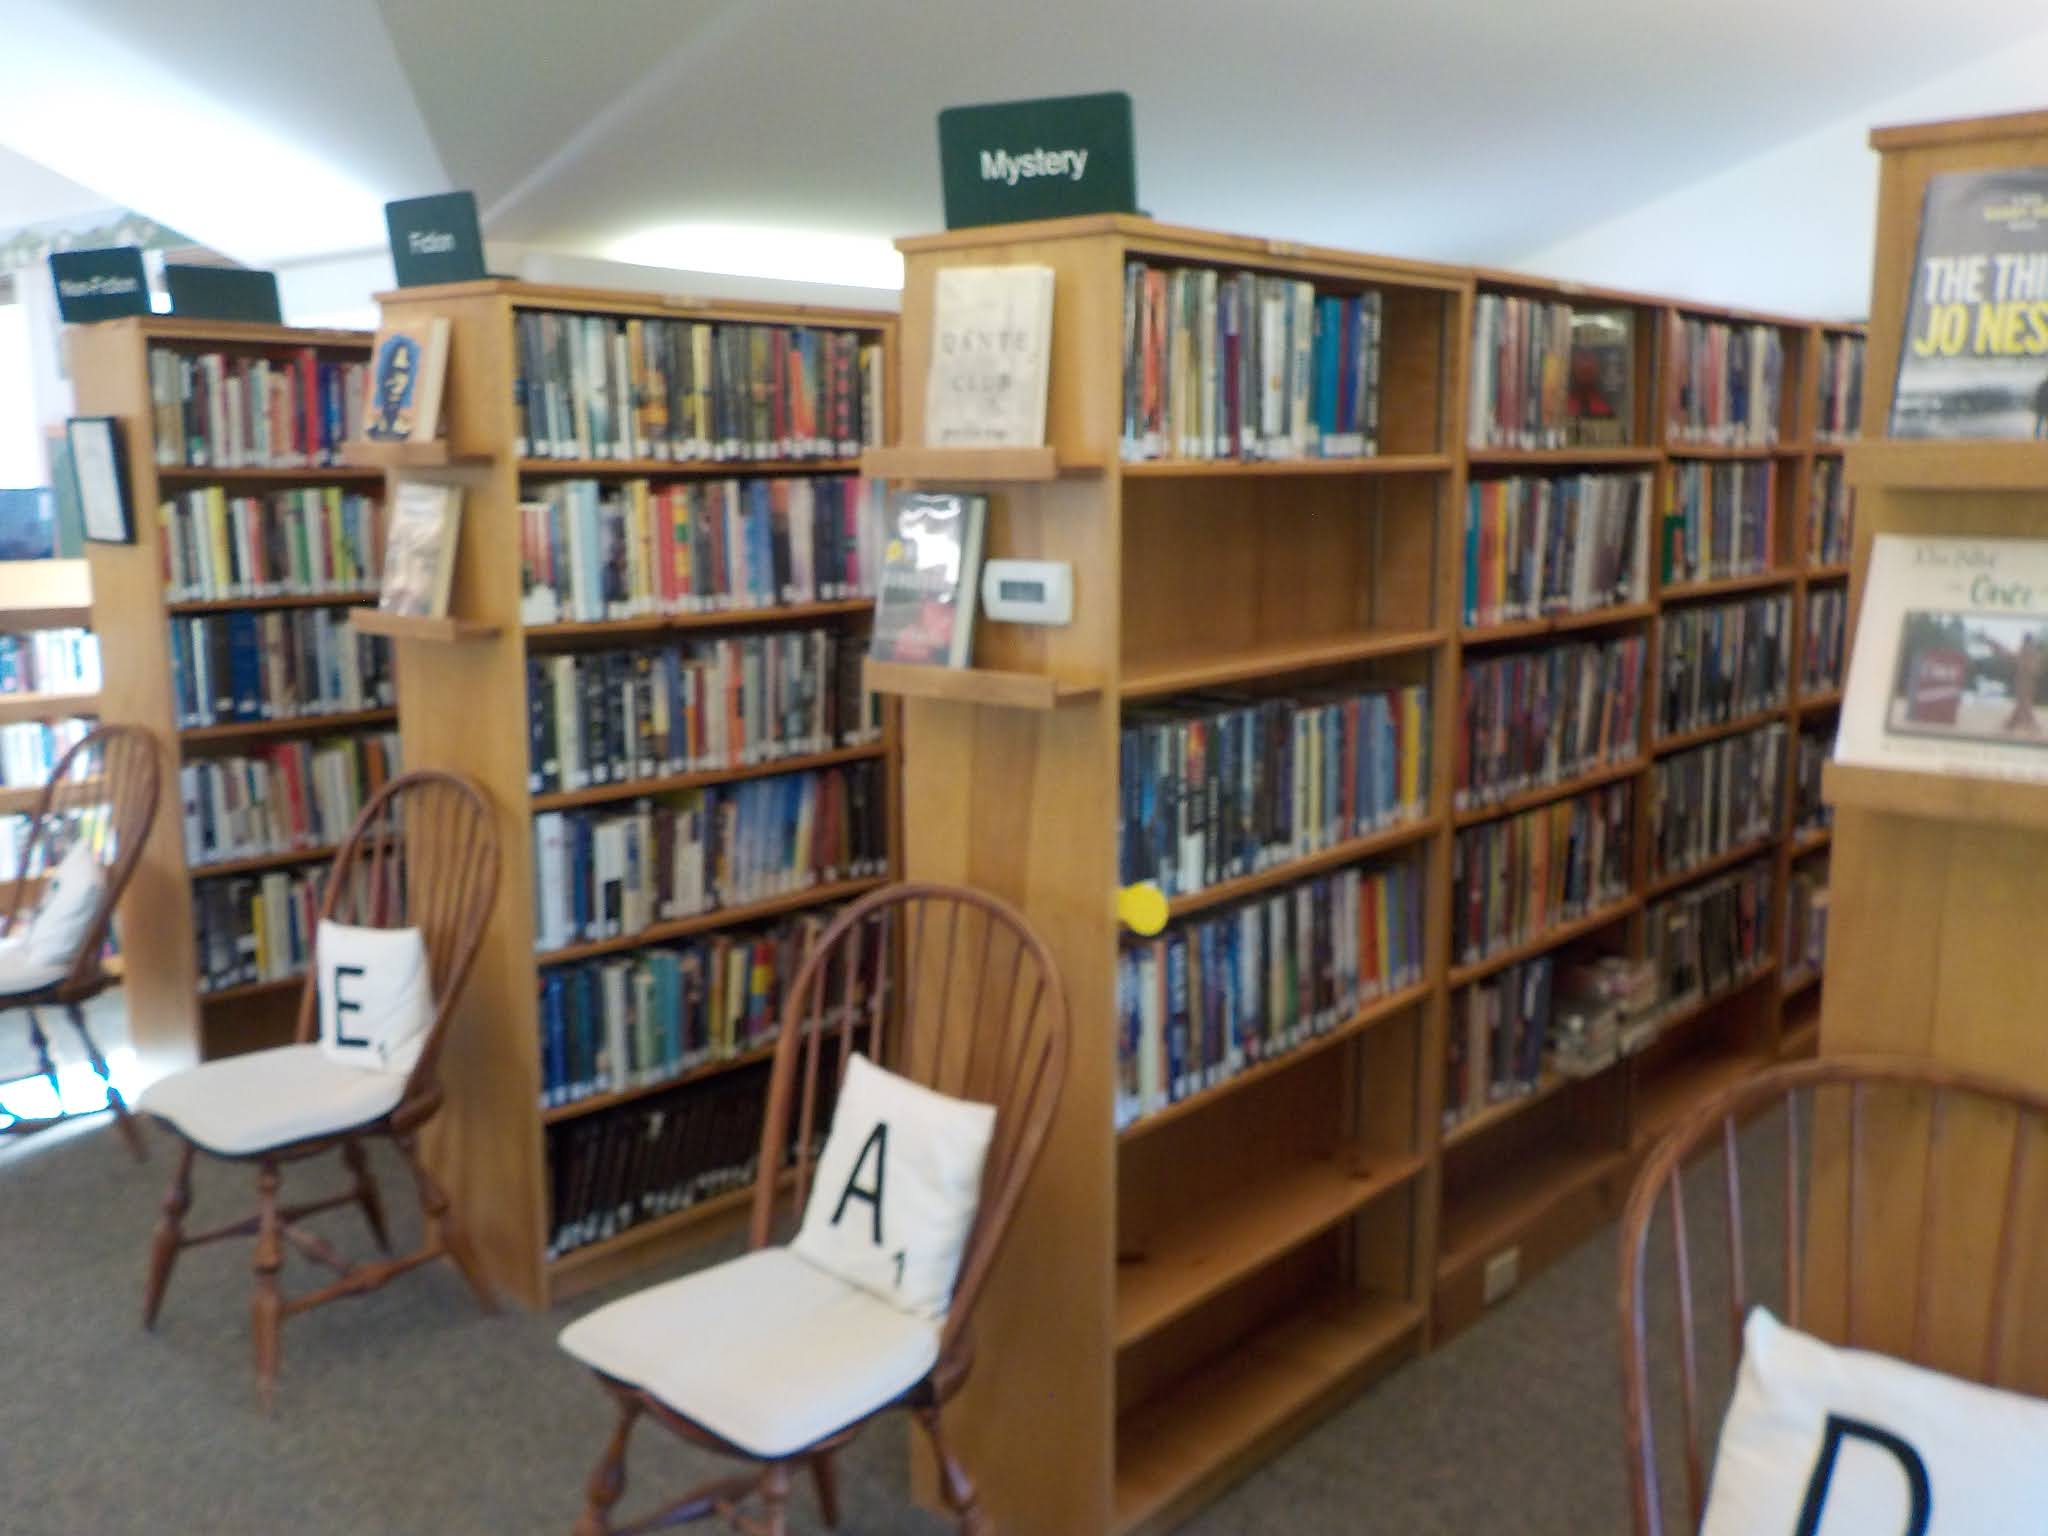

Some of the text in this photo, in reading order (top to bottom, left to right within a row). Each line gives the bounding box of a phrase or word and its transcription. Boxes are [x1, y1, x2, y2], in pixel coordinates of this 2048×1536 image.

[981, 148, 1089, 185] Mystery
[1924, 256, 1987, 305] THE
[1913, 302, 1969, 357] JO
[334, 965, 369, 1049] E
[830, 1121, 888, 1246] A
